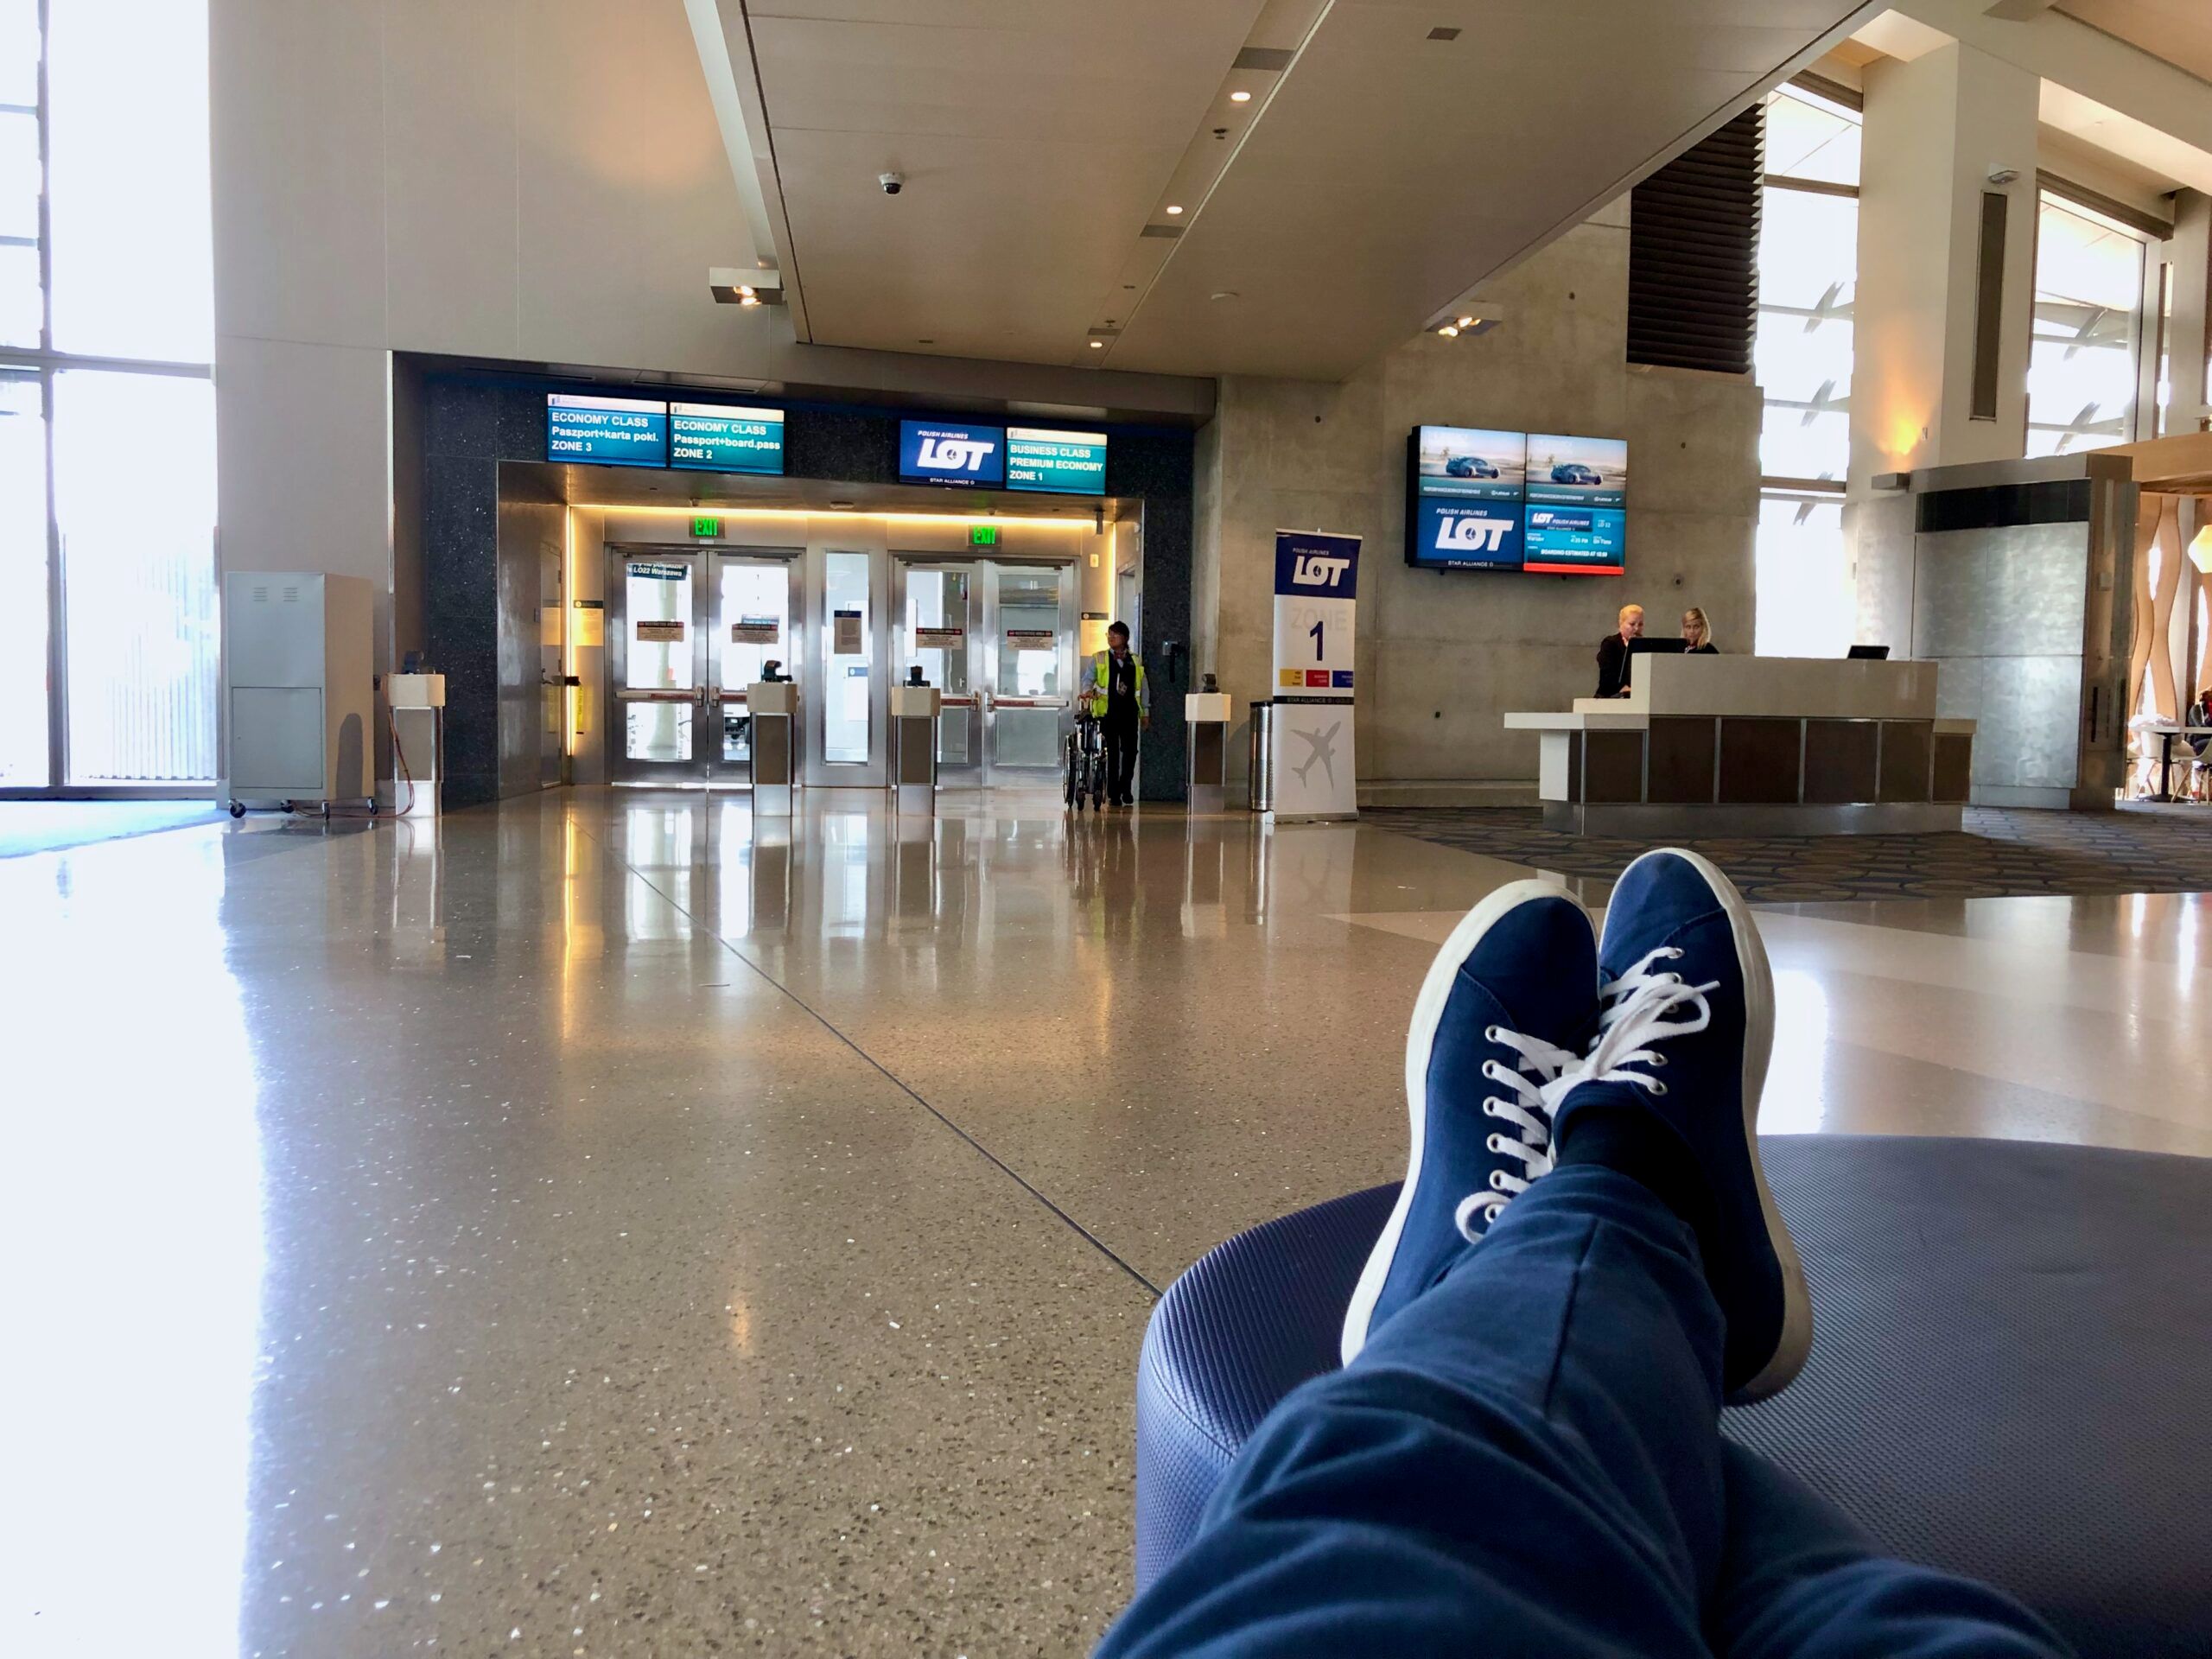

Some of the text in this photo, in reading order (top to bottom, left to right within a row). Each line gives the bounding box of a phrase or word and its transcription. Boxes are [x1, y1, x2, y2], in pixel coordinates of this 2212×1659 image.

[552, 412, 648, 428] ECONOMY CLASS
[674, 420, 766, 435] ECONOMY CLASS
[552, 426, 631, 440] Paszport+karta
[941, 431, 969, 440] AIRLINES
[551, 441, 592, 452] ZONE 3
[674, 434, 780, 450] Passport+board.pass
[674, 448, 713, 460] ZONE 2
[917, 438, 995, 471] LOT
[1010, 444, 1090, 459] BUSINESS CLASS
[1009, 457, 1103, 472] PREMIUM ECONOMY
[1009, 469, 1043, 481] ZONE 1
[1459, 508, 1488, 517] AIRLINES
[1532, 512, 1554, 524] LOT
[695, 517, 718, 536] EXIT
[1435, 517, 1515, 551] LOT
[973, 525, 995, 544] EXIT
[1293, 556, 1351, 587] LOT
[1309, 620, 1324, 662] 1
